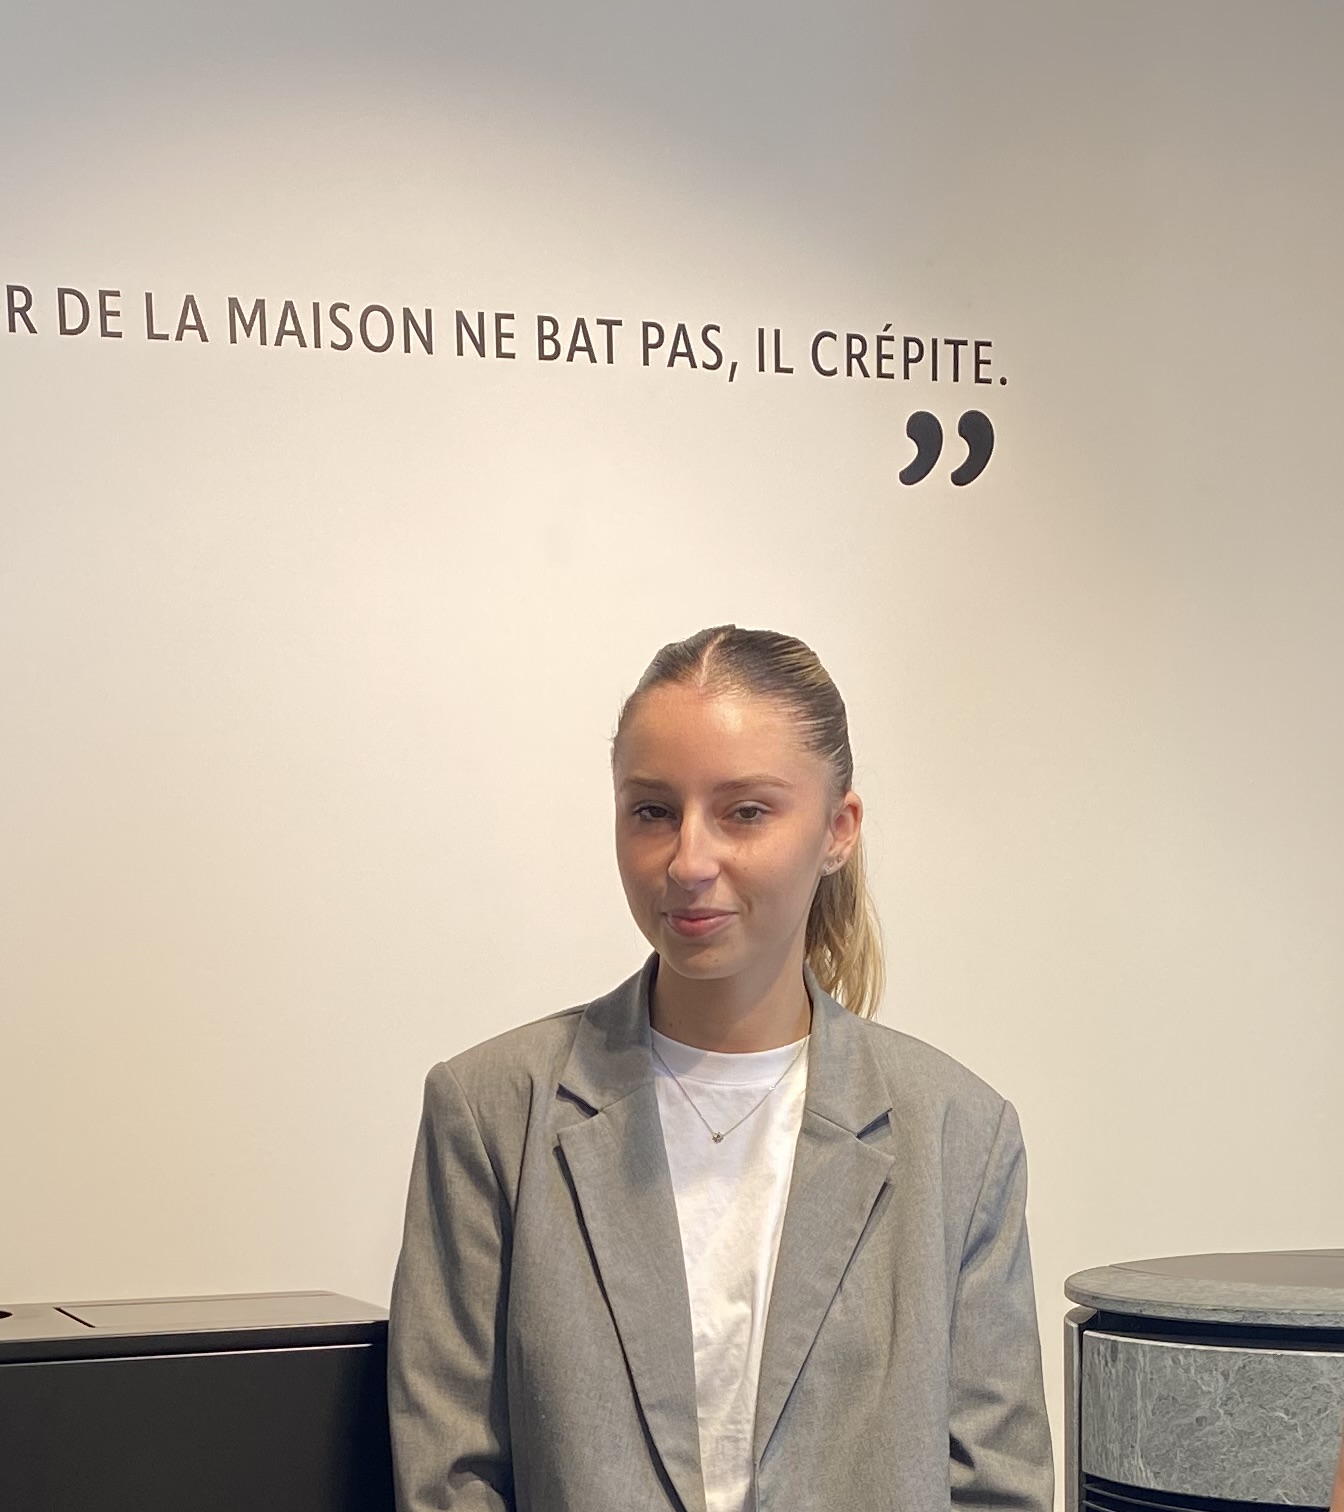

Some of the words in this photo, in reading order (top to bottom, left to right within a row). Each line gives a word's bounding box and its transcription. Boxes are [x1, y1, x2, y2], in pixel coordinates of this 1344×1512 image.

[57, 287, 124, 339] DE
[144, 291, 210, 343] LA
[226, 296, 436, 357] MAISON
[454, 309, 517, 361] NE
[535, 314, 623, 366] BAT
[640, 320, 739, 382] PAS,
[756, 327, 794, 375] IL
[811, 323, 1010, 386] CRÉPITE.
